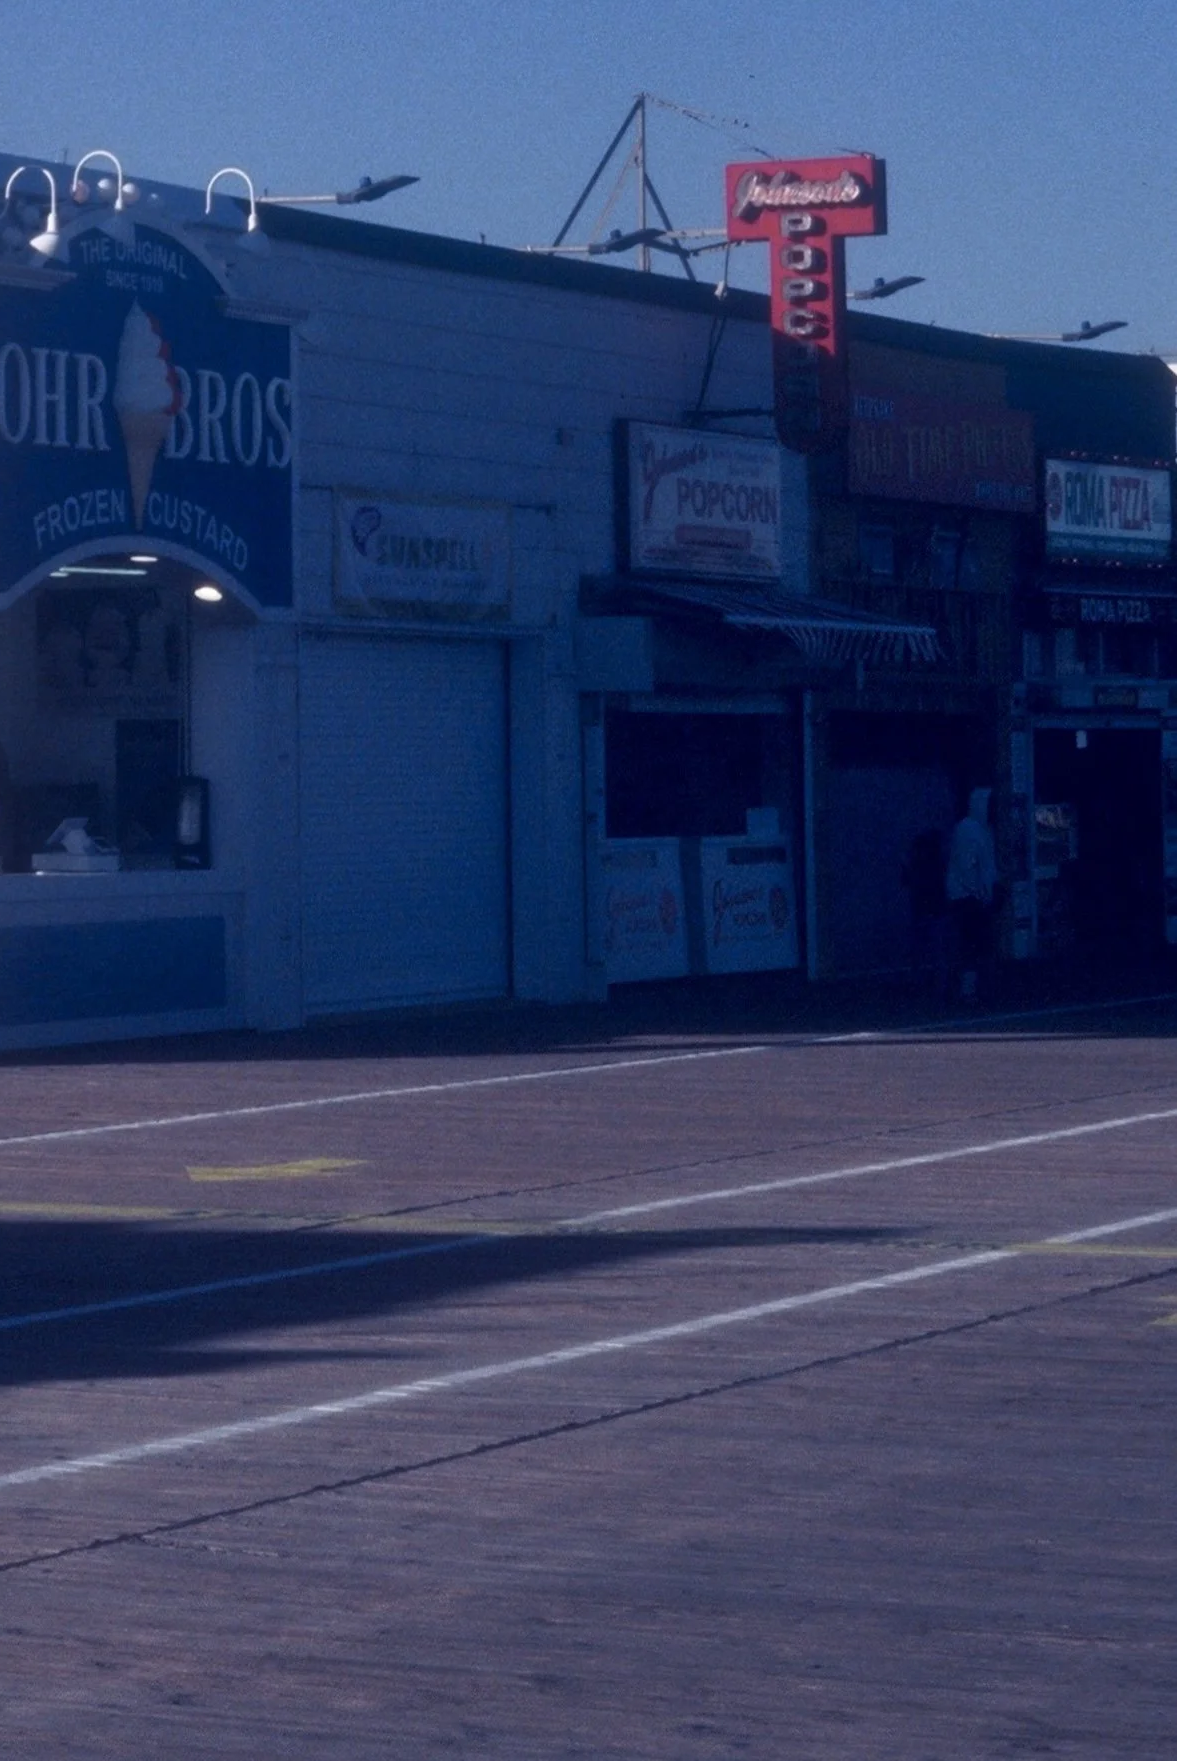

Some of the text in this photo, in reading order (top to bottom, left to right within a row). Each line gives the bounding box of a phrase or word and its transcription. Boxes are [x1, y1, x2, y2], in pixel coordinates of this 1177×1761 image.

[80, 238, 188, 280] THE ORIGINAL
[106, 269, 138, 290] SINCE
[165, 365, 292, 469] BROS
[677, 477, 777, 524] POPCORN
[1065, 471, 1108, 527] ROMA
[1109, 475, 1152, 531] PIZZA
[32, 489, 248, 571] FROZEN CUSTARD
[1080, 597, 1115, 622] ROMA
